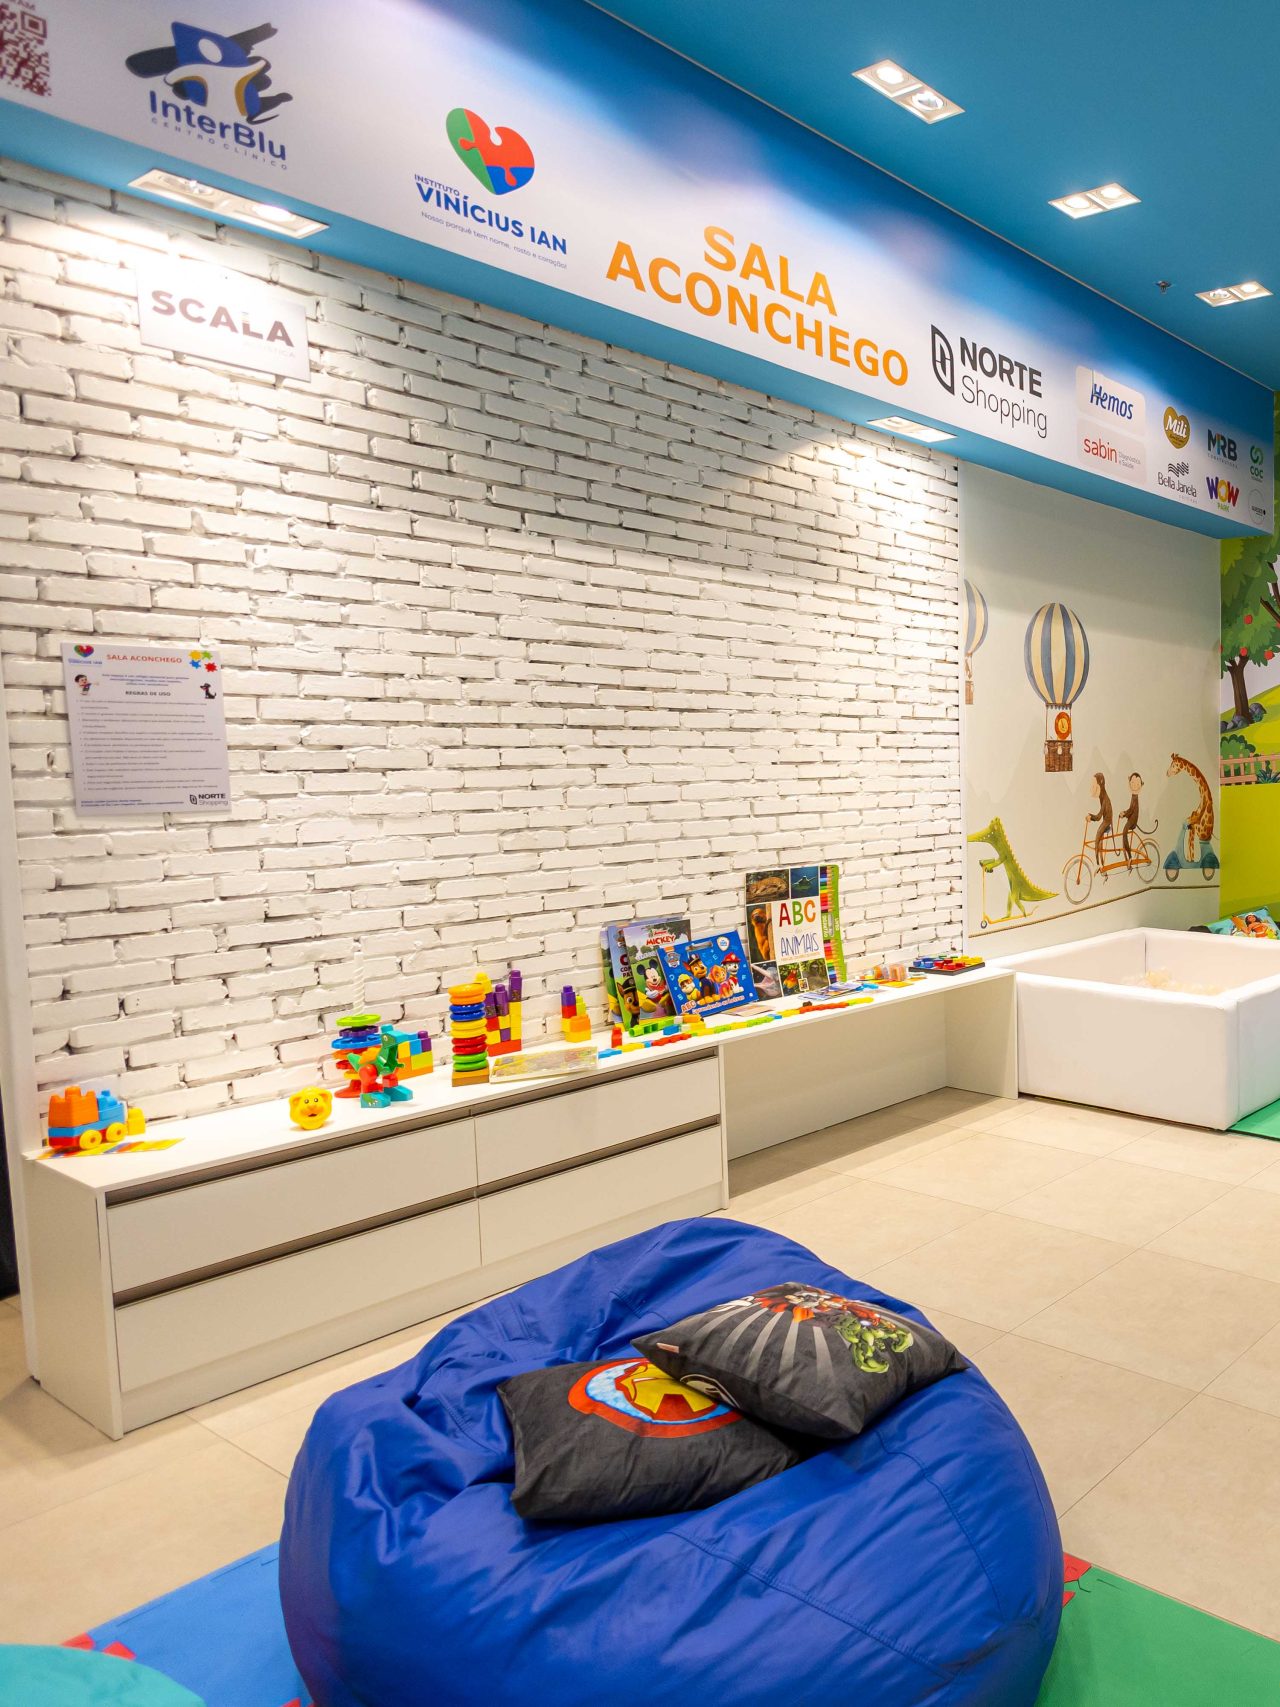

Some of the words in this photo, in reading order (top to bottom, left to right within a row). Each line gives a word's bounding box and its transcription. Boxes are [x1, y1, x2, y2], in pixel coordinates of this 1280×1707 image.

[149, 90, 287, 161] InterBlu
[151, 117, 215, 145] CENTRO
[414, 174, 460, 196] INSTITUTO
[416, 182, 524, 238] VINÍCIUS
[530, 226, 567, 255] IAN
[421, 211, 444, 225] Nosso
[473, 230, 488, 240] tem
[704, 225, 837, 317] SALA
[151, 290, 295, 348] SCALA
[606, 240, 908, 386] ACONCHEGO
[960, 336, 1042, 398] NORTE
[962, 375, 1047, 438] Shopping
[1090, 383, 1134, 420] Hemos
[1165, 415, 1187, 438] Mili
[1083, 438, 1118, 463] sabin
[1207, 429, 1238, 462] MRB
[1157, 471, 1176, 490] Bella
[1175, 480, 1197, 498] Janela
[1206, 476, 1240, 507] WOW
[130, 655, 182, 664] ACONCHEGO
[779, 899, 816, 927] ABC
[646, 935, 675, 945] MICKEY
[781, 932, 819, 957] ANIMAIS
